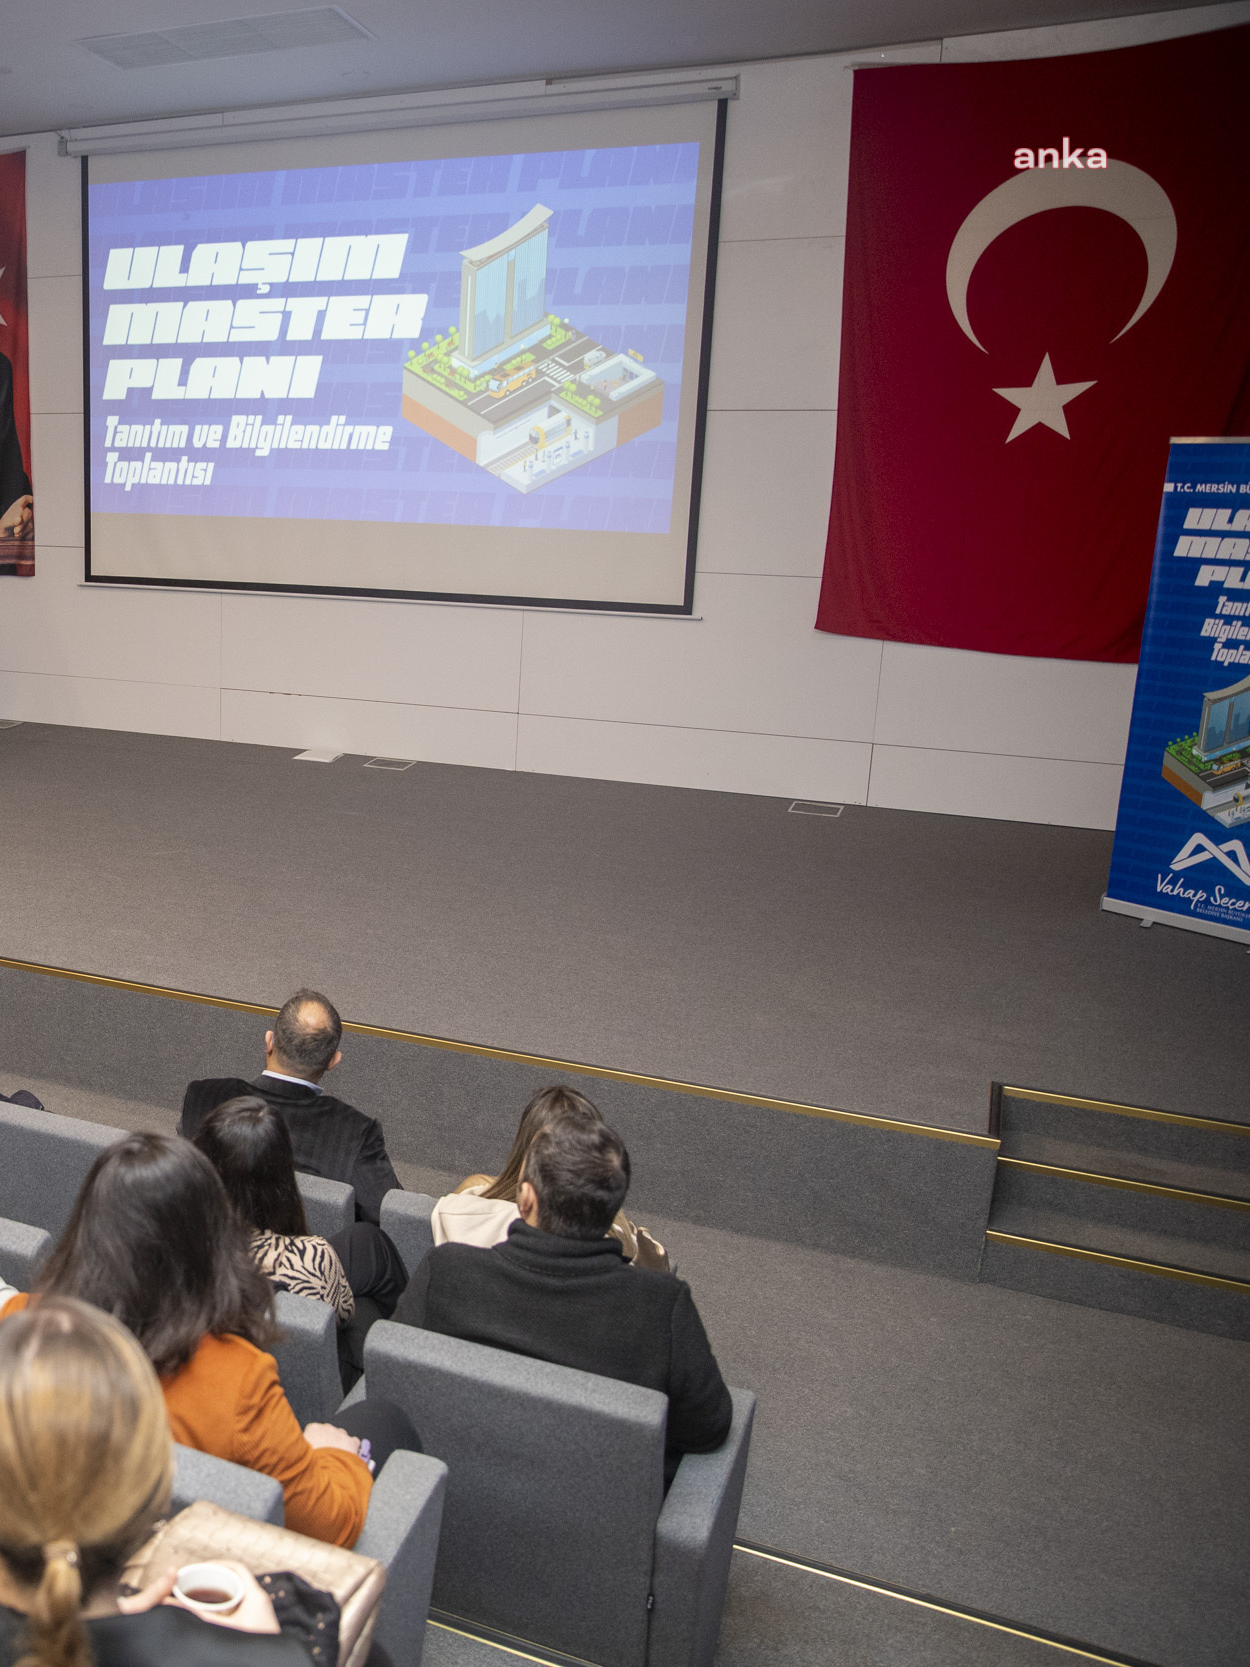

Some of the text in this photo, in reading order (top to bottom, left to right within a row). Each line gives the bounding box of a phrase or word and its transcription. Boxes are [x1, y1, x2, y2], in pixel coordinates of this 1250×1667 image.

[103, 233, 409, 294] ULAŞIM
[102, 293, 429, 346] MASTER
[102, 355, 323, 400] PLANI
[104, 415, 393, 456] Tanıtım ve Bilgilendirme
[104, 452, 215, 491] Toplantısı
[1176, 483, 1193, 492] T.C.
[1195, 481, 1237, 494] MERSİN
[1173, 535, 1250, 561] MA
[1210, 642, 1250, 667] Topla
[1156, 873, 1207, 910] Vahap
